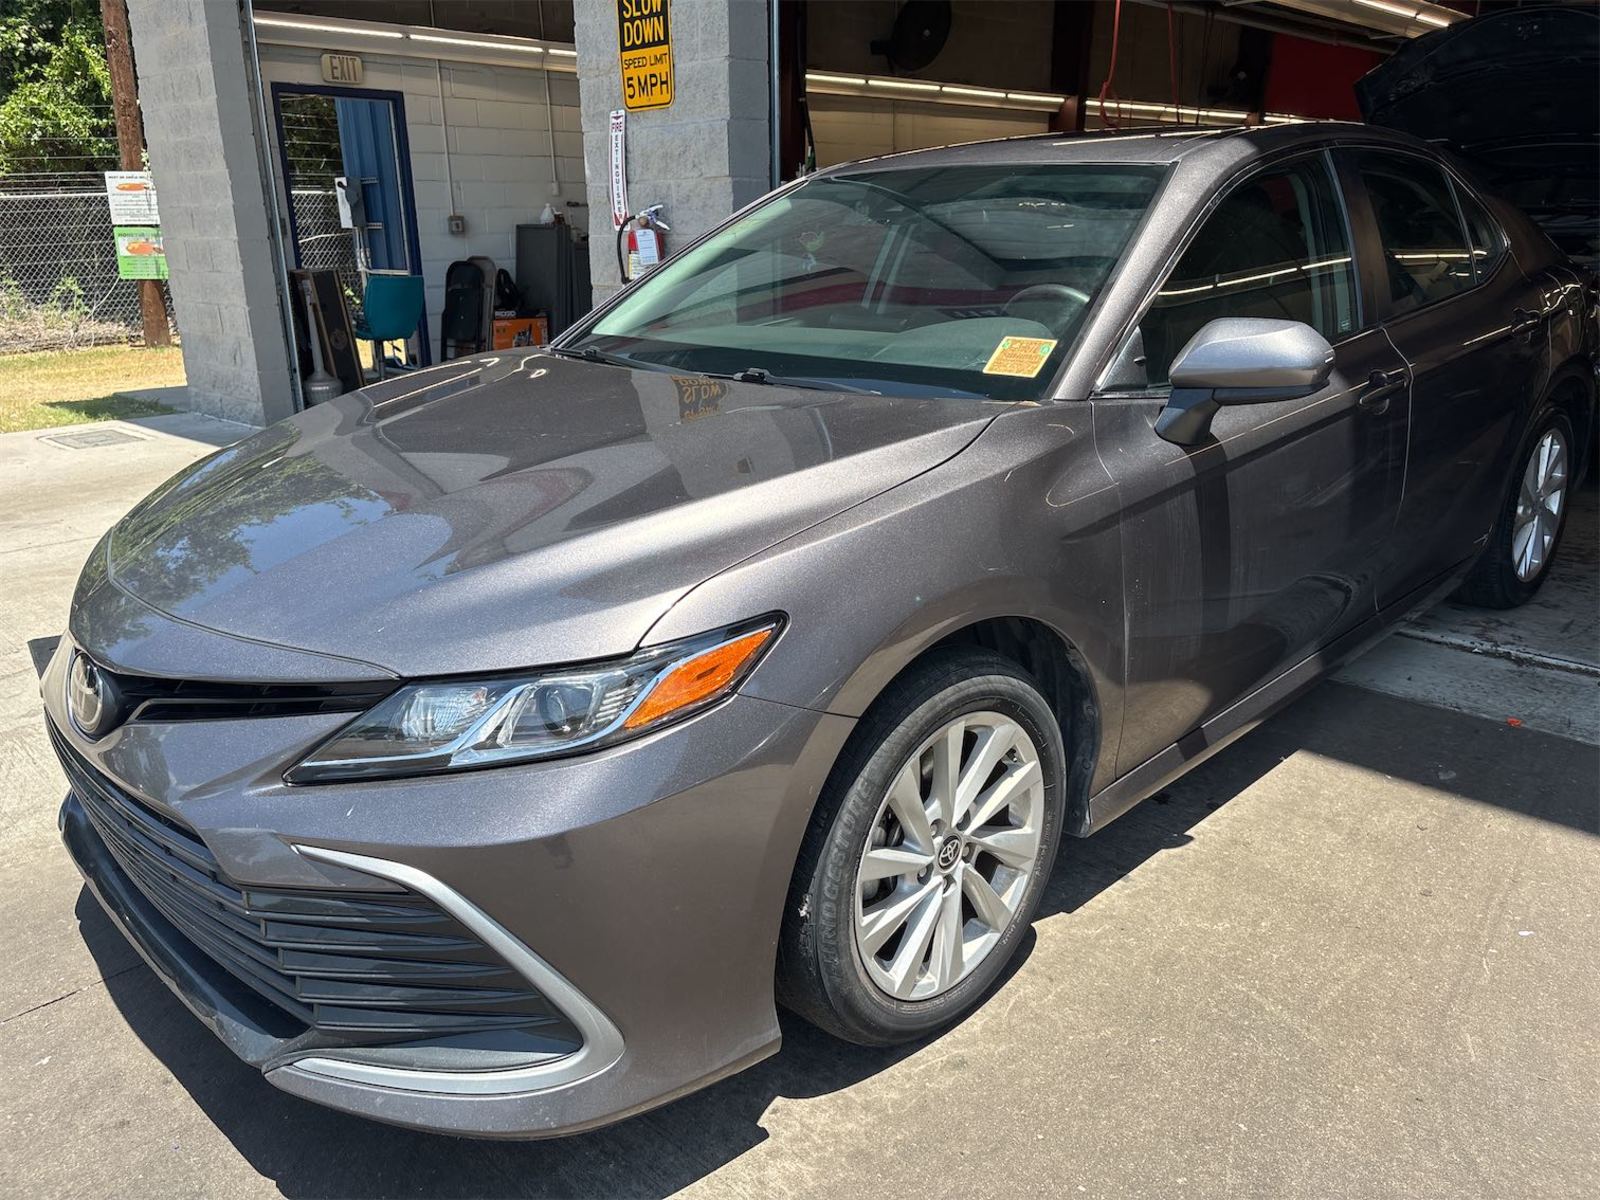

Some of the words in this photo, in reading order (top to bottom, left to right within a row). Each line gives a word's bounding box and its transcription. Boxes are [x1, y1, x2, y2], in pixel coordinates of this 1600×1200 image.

[624, 16, 664, 47] DOWN
[329, 56, 357, 81] EXIT
[624, 56, 648, 70] SPEED
[649, 53, 668, 66] LIMIT
[626, 76, 636, 99] 5
[637, 71, 669, 98] MPH
[611, 122, 623, 132] FIRE
